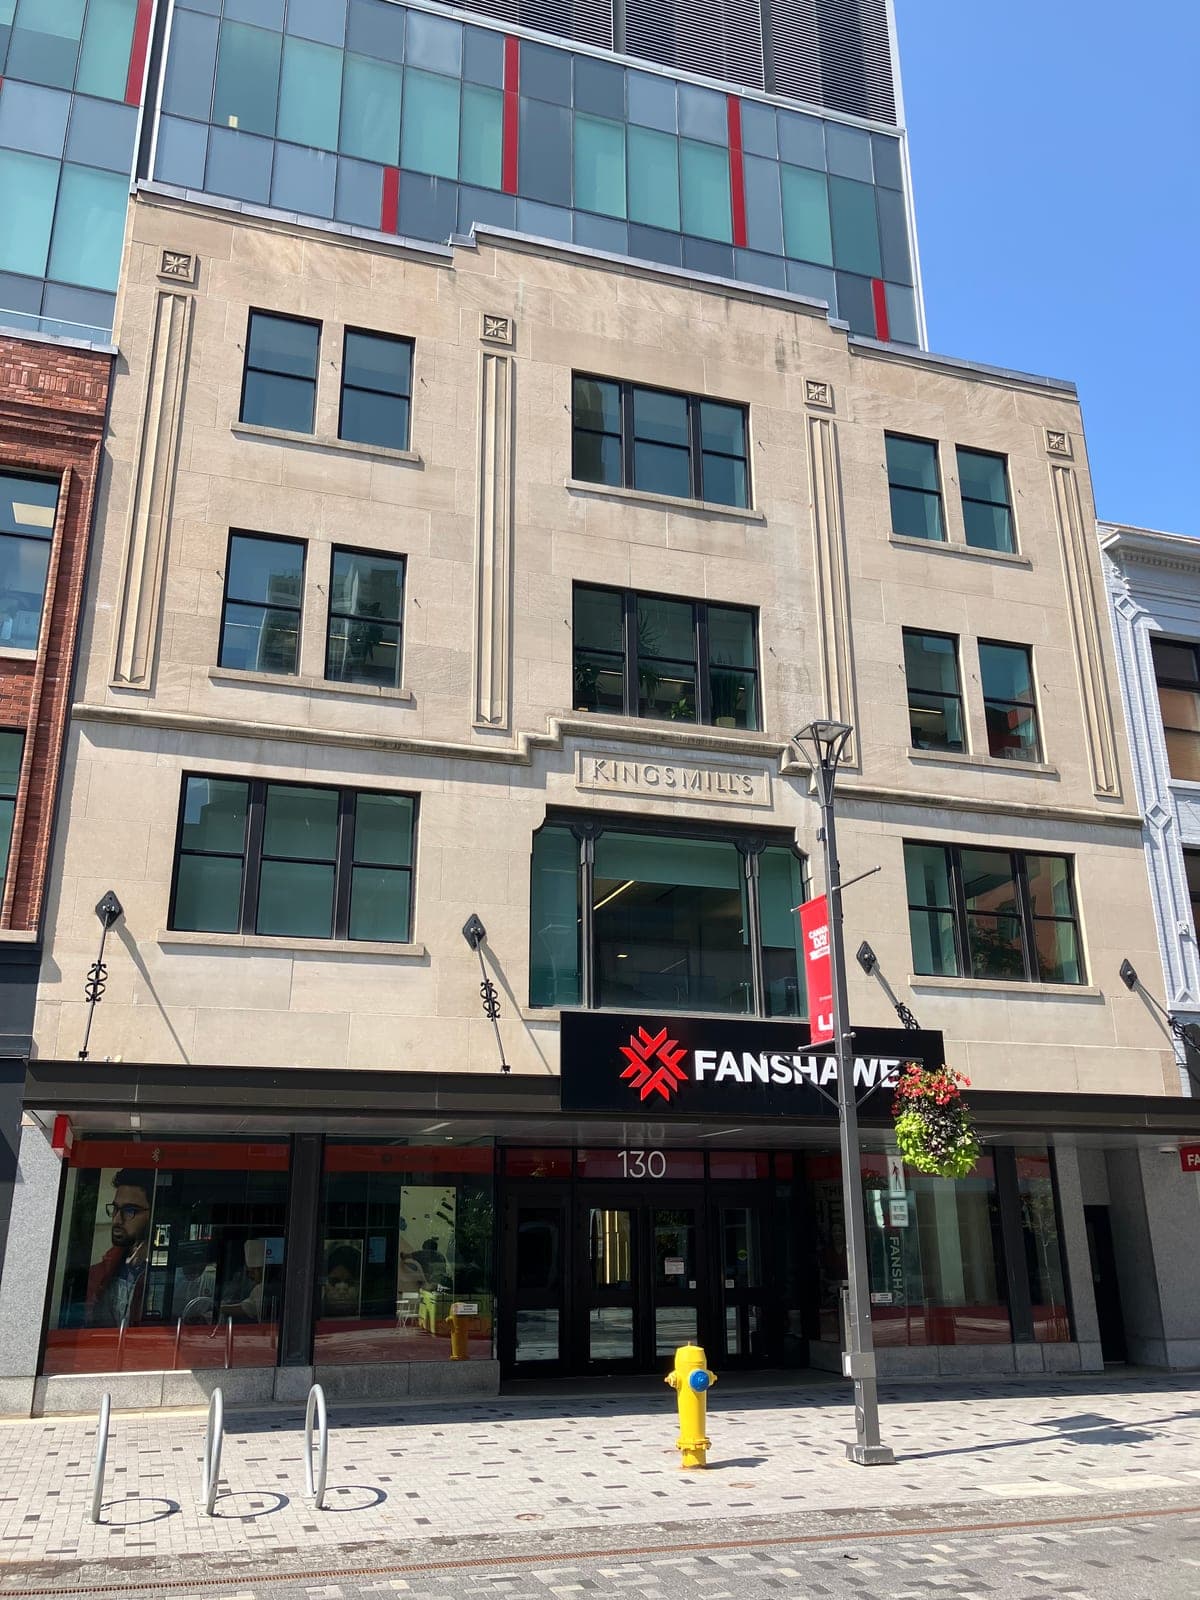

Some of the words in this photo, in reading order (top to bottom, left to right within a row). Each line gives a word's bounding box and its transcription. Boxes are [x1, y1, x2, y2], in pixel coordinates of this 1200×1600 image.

[593, 759, 754, 795] KINGSMILL'S
[694, 1050, 900, 1088] FANSHAWE
[617, 1151, 666, 1178] 130
